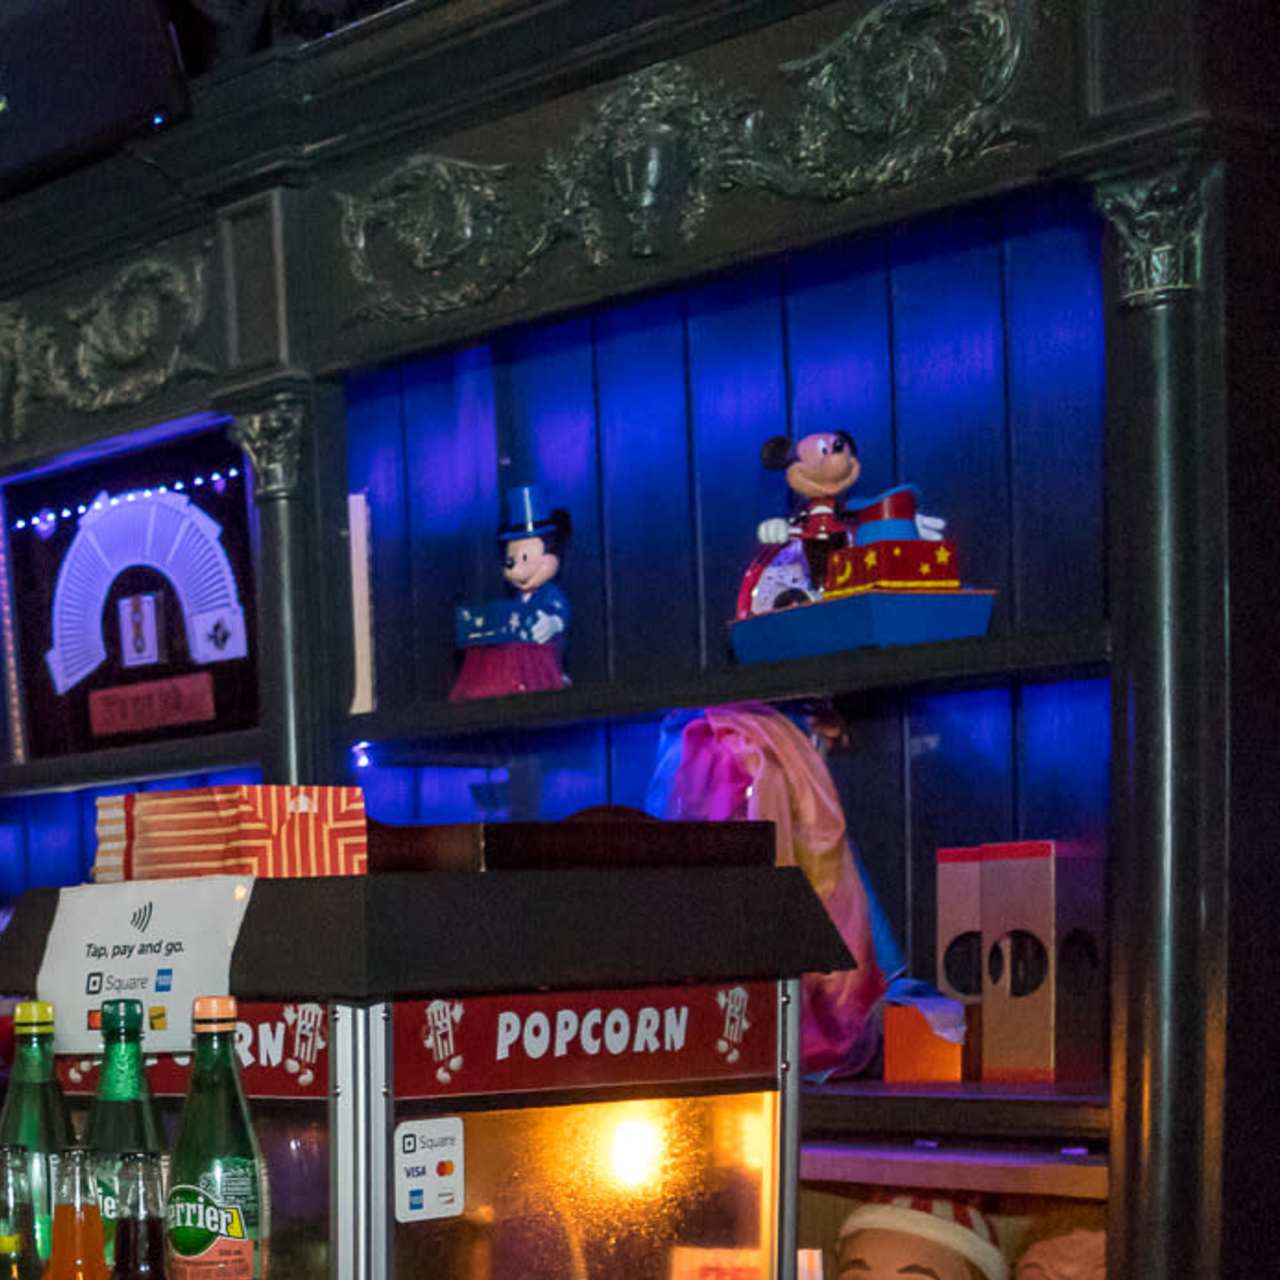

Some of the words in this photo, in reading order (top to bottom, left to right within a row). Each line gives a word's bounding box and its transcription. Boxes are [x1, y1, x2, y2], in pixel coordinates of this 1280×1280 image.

[85, 943, 108, 959] Tap,
[111, 944, 134, 959] pay
[139, 940, 164, 955] and
[164, 940, 184, 957] go.
[105, 975, 149, 992] Square
[496, 1006, 688, 1061] POPCORN
[419, 1135, 457, 1151] Square
[403, 1165, 427, 1178] VISA
[168, 1195, 233, 1238] errier
